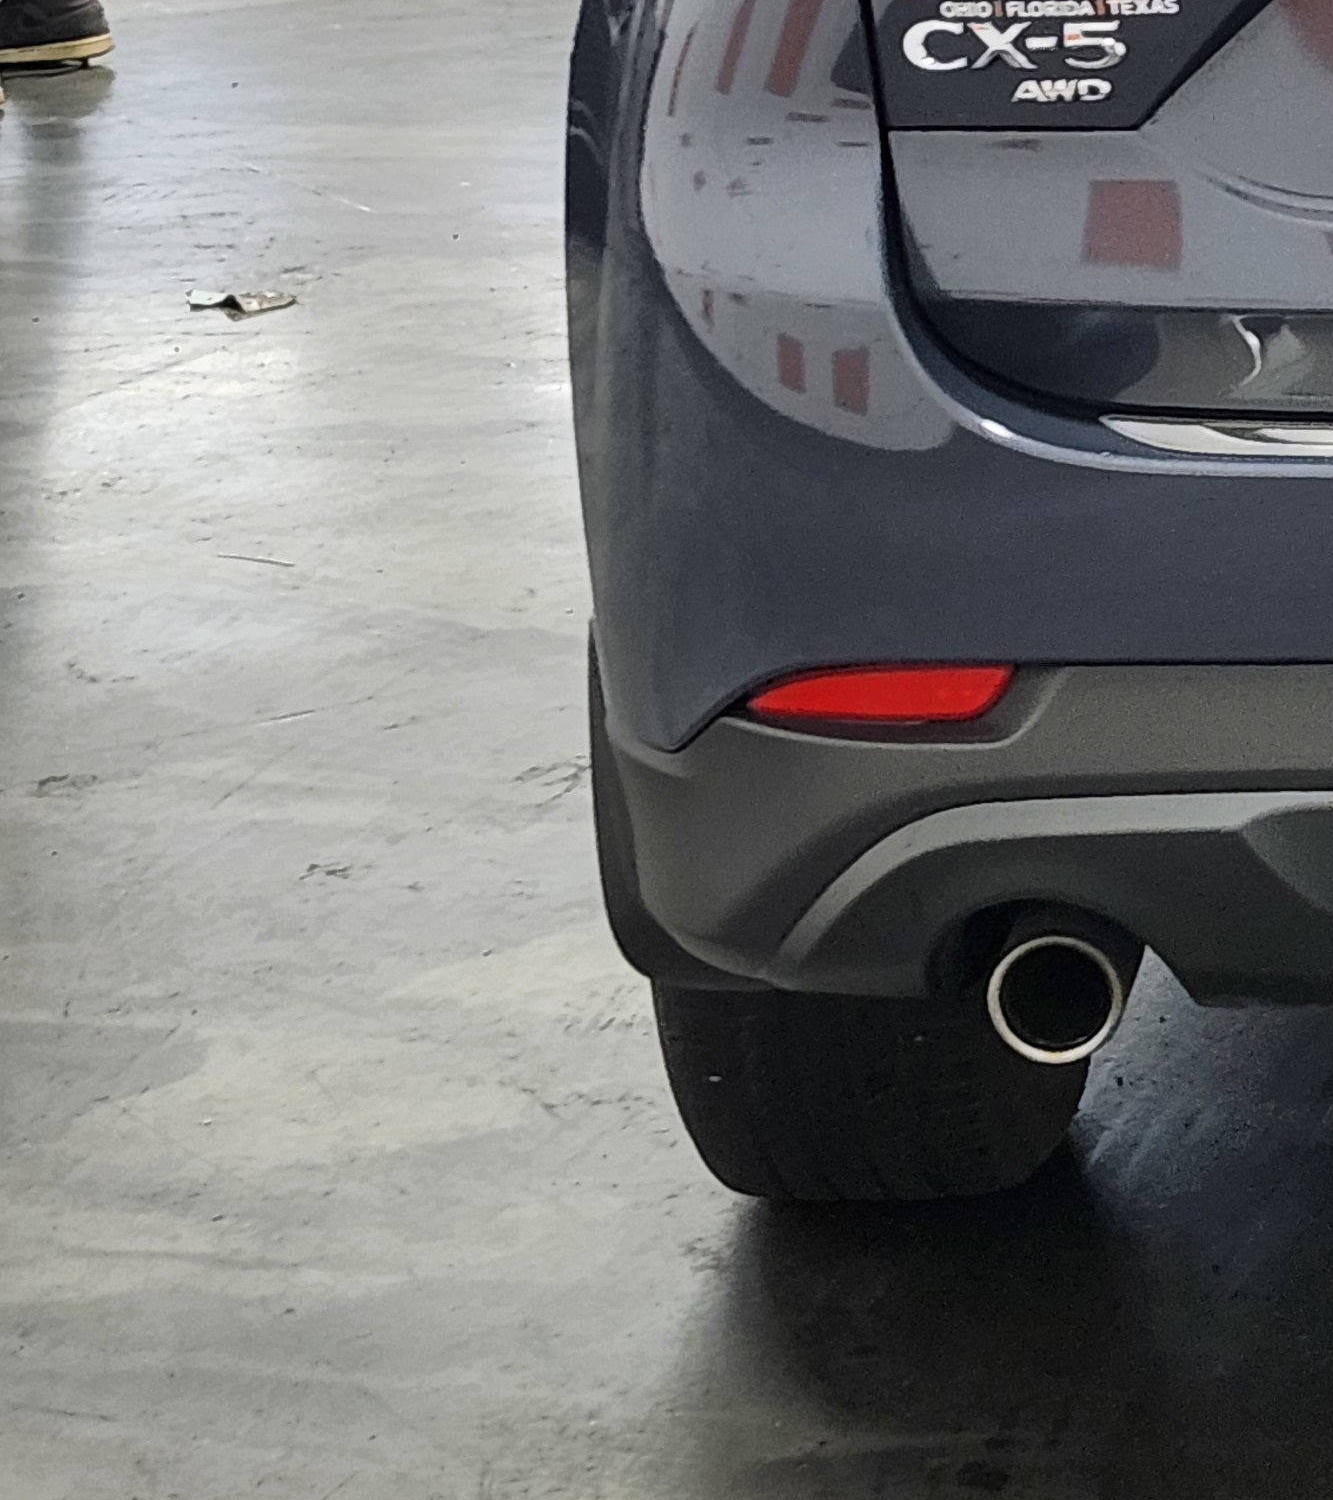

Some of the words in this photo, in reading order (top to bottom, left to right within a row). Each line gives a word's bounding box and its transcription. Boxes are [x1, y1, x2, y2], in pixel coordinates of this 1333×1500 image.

[939, 0, 993, 18] OHIO
[1004, 0, 1096, 18] FLORIDA
[902, 19, 1128, 71] CX-5
[1010, 77, 1113, 103] AWD
